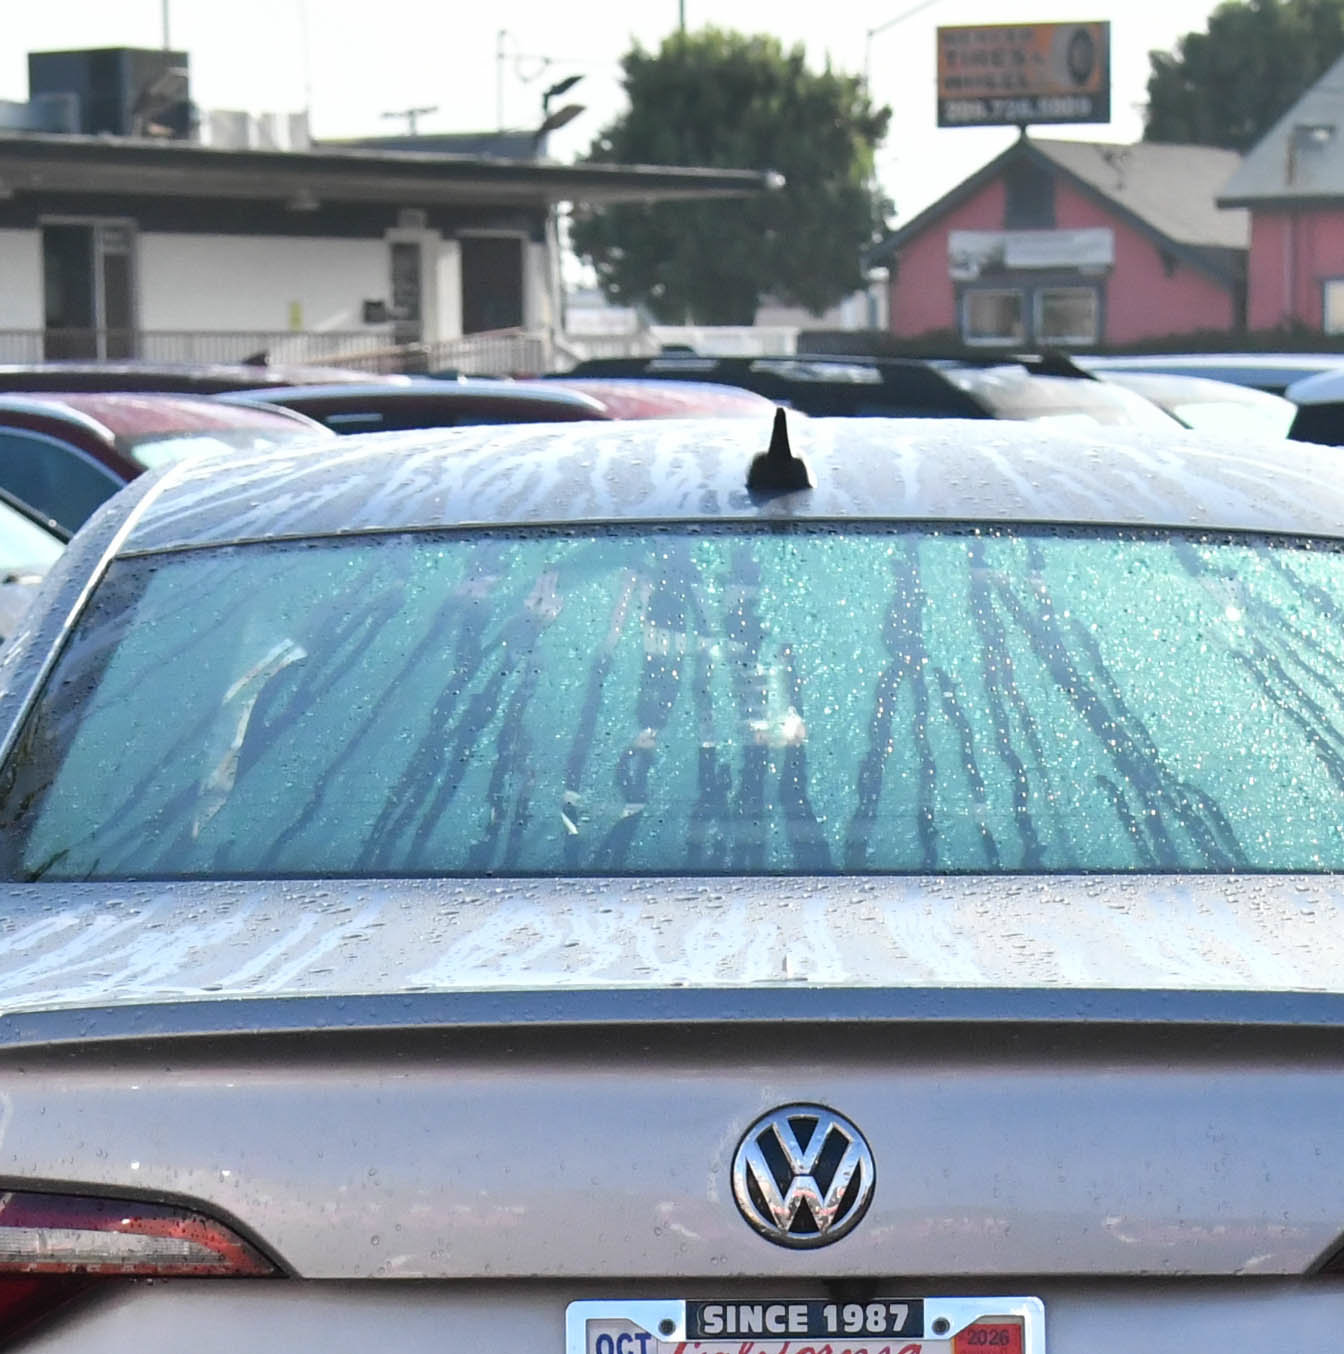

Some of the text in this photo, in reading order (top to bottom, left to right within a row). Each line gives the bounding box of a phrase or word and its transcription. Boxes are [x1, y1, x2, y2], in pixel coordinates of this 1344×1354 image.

[704, 1304, 910, 1334] SINCE 1987
[967, 1328, 1010, 1346] 2026
